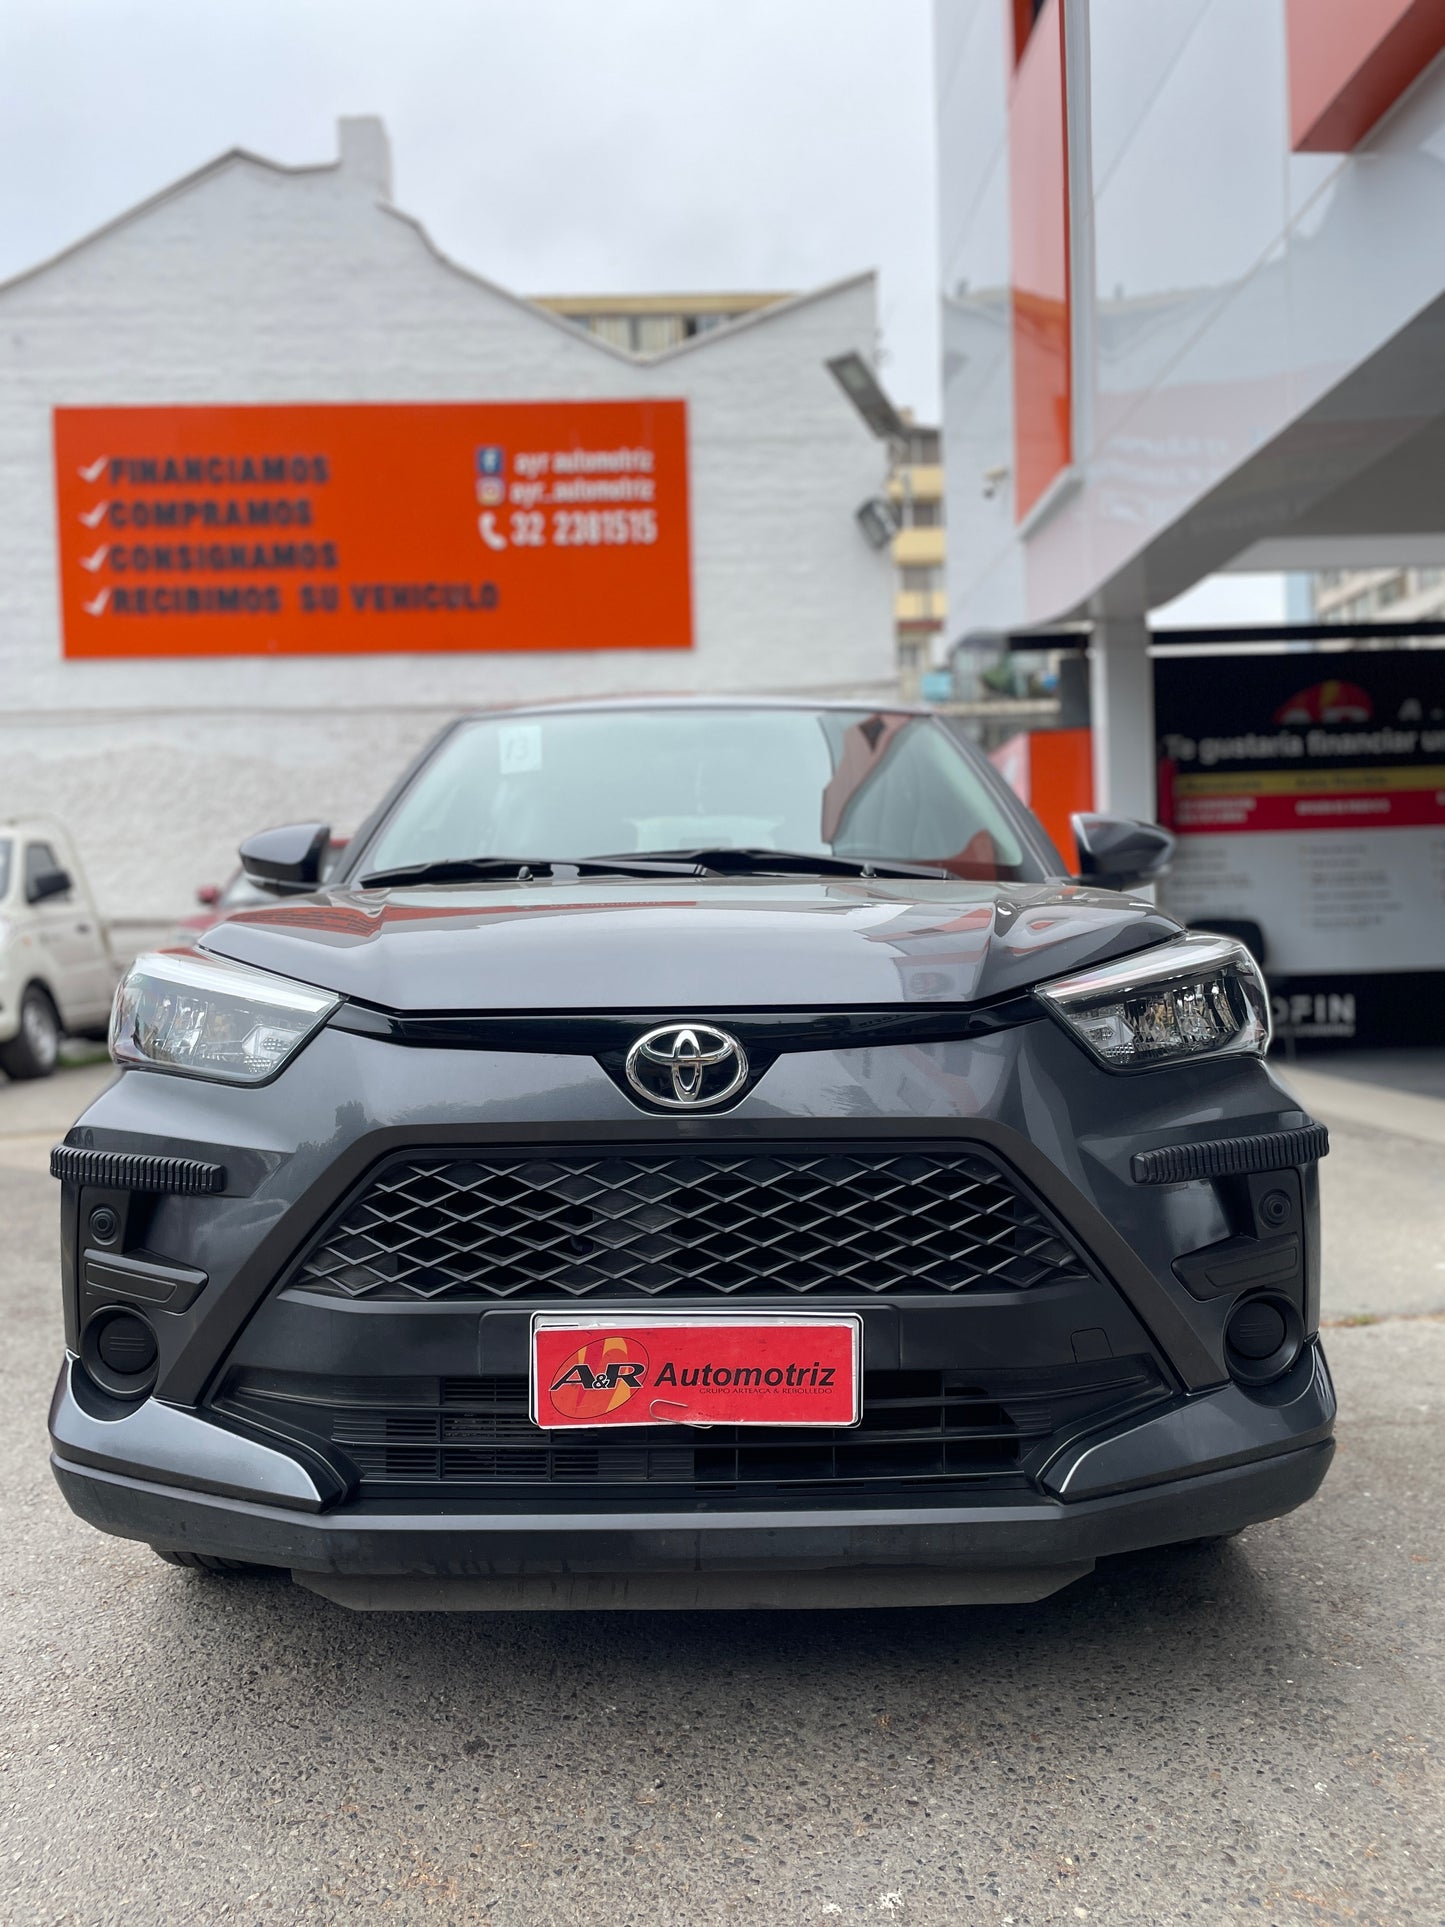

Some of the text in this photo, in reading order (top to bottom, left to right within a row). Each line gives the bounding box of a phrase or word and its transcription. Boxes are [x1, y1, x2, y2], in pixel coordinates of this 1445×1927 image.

[110, 456, 329, 484] FINANCIAMOS
[552, 447, 654, 475] automotriz
[110, 498, 312, 529] COMPRAMOS
[510, 510, 546, 546] 32
[110, 541, 338, 573] CONSIGNAMOS
[112, 586, 281, 616] RECIBIMOS
[301, 583, 340, 613] SU
[1163, 733, 1197, 761] Te
[1306, 726, 1418, 757] financiar
[549, 1362, 836, 1391] A&R Automotriz
[699, 1387, 730, 1395] GRUPO
[782, 1387, 833, 1395] REBOLLEDO
